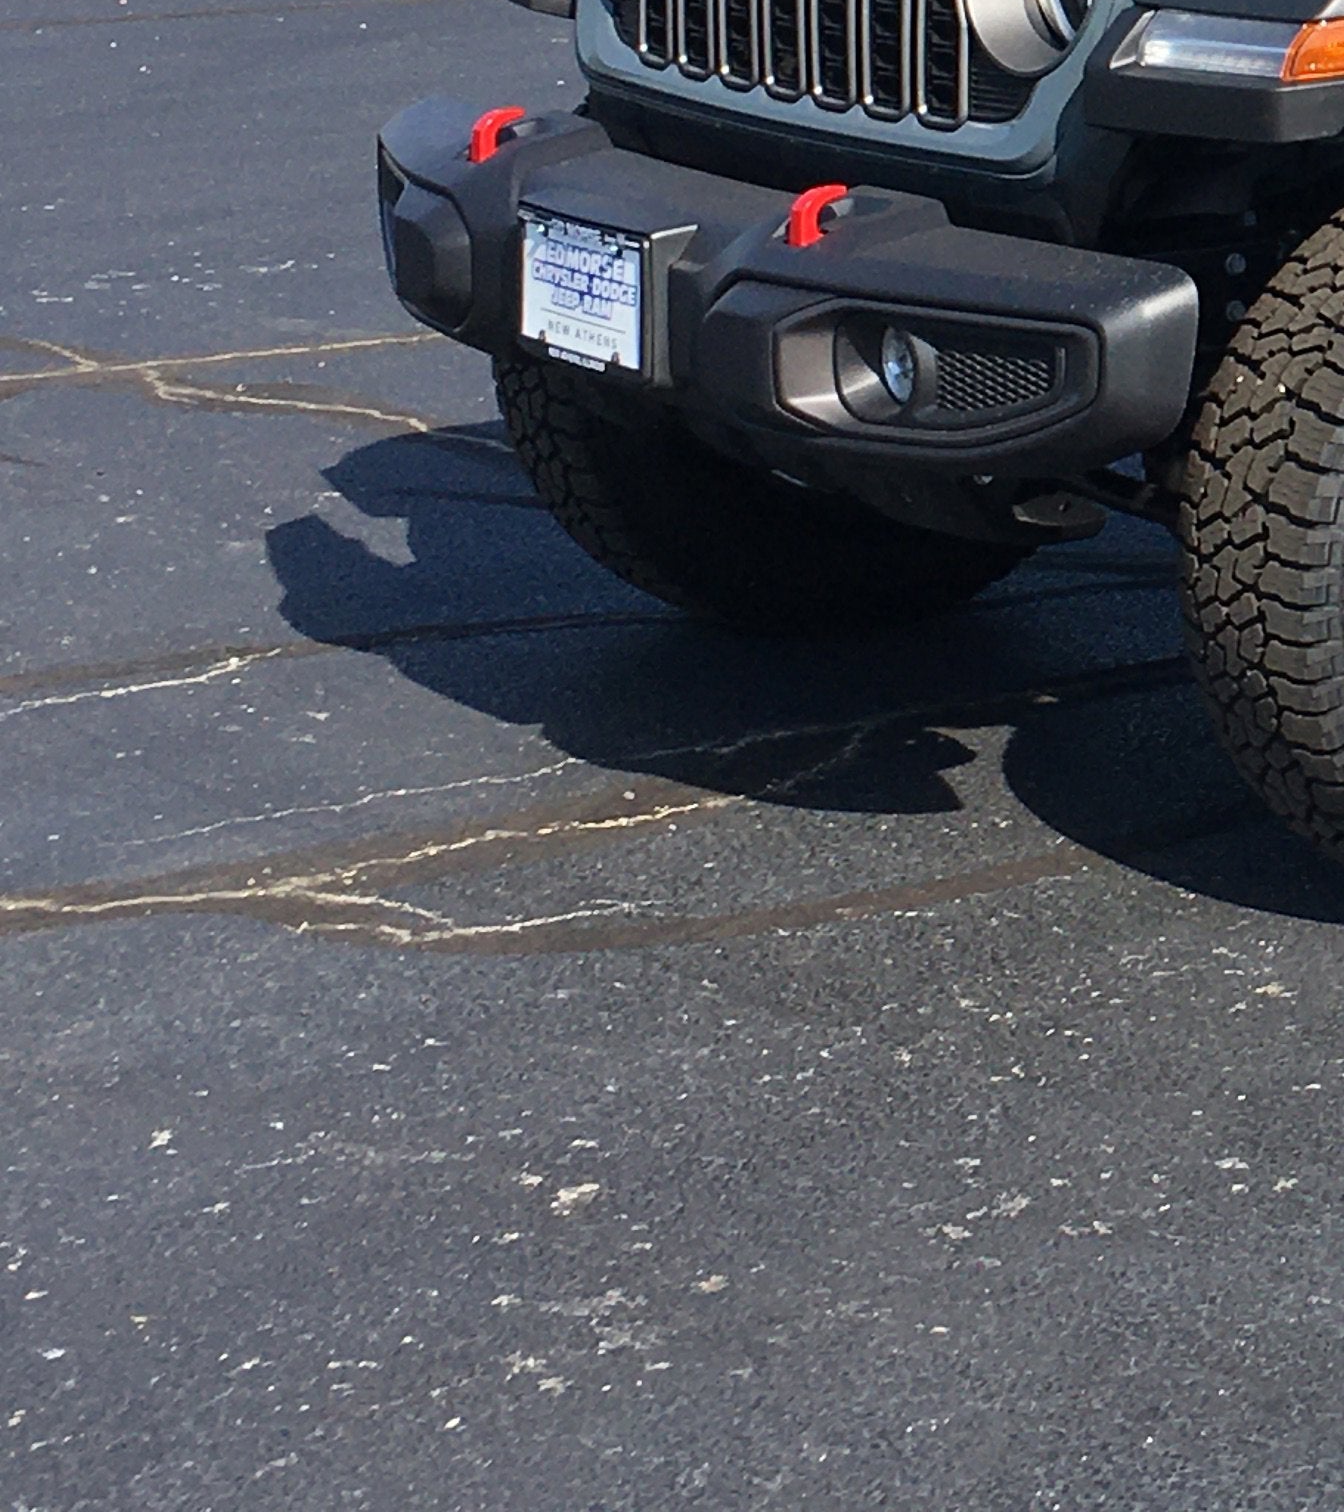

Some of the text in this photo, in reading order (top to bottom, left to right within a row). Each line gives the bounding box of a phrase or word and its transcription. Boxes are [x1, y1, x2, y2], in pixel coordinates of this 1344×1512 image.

[546, 240, 626, 281] ED MORSE
[532, 260, 638, 306] CHRYSLER DODGE
[582, 294, 613, 321] RAM
[548, 319, 619, 350] NEW ATHENS
